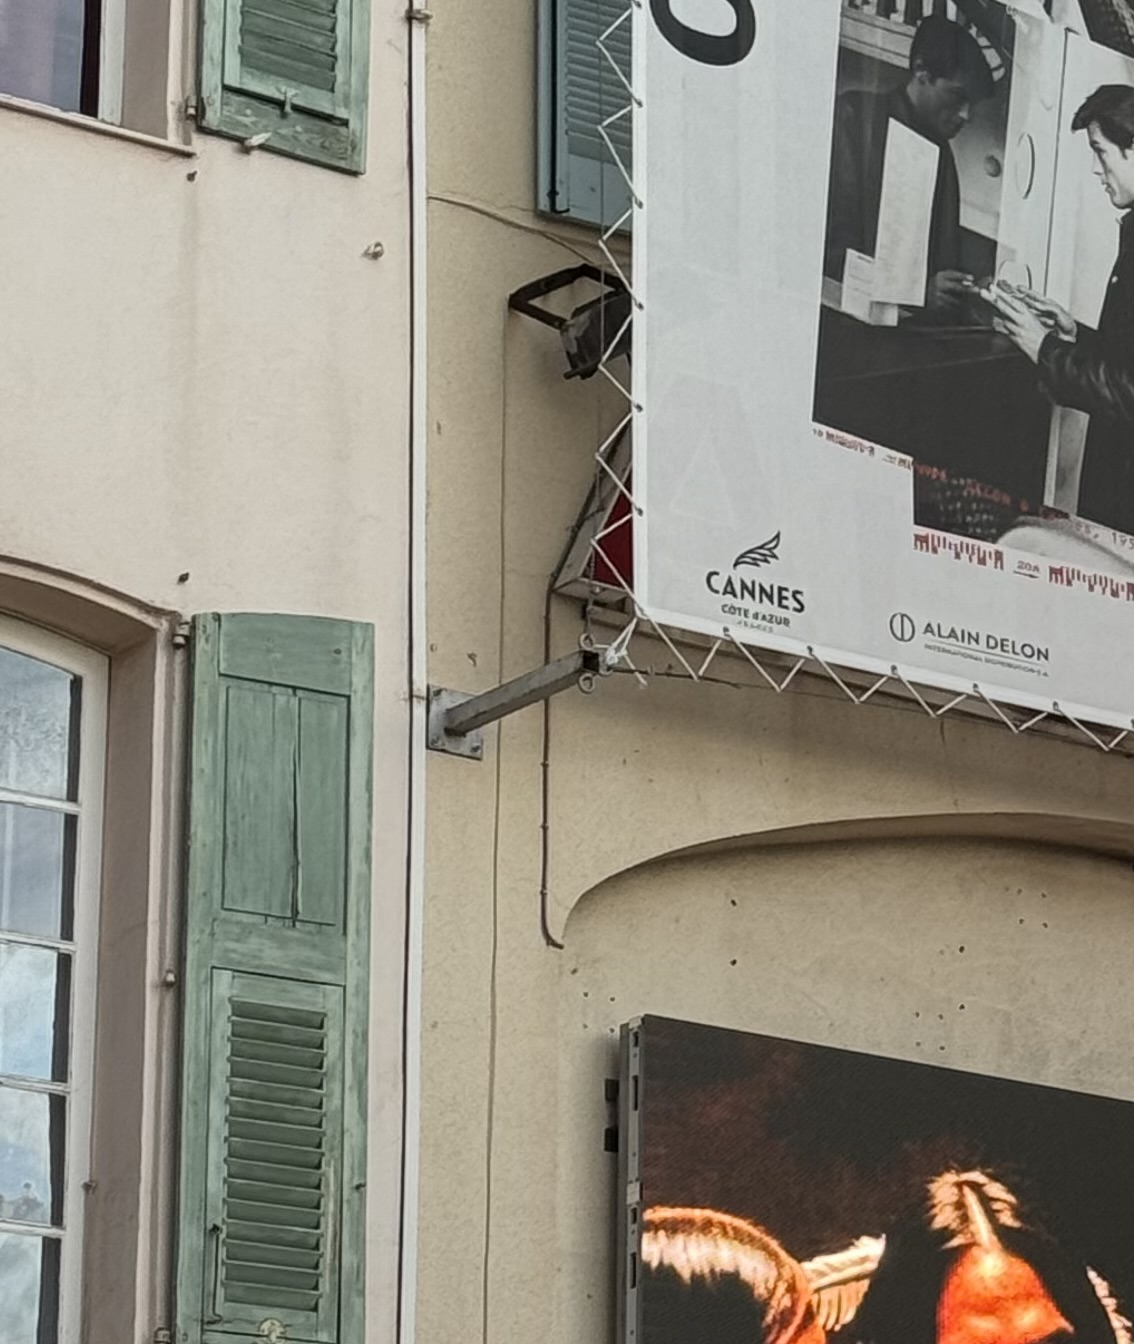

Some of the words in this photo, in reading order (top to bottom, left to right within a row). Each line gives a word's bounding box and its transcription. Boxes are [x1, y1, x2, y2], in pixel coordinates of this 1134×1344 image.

[705, 570, 805, 614] CANNES
[922, 622, 980, 646] ALAIN
[985, 634, 1049, 662] DELON
